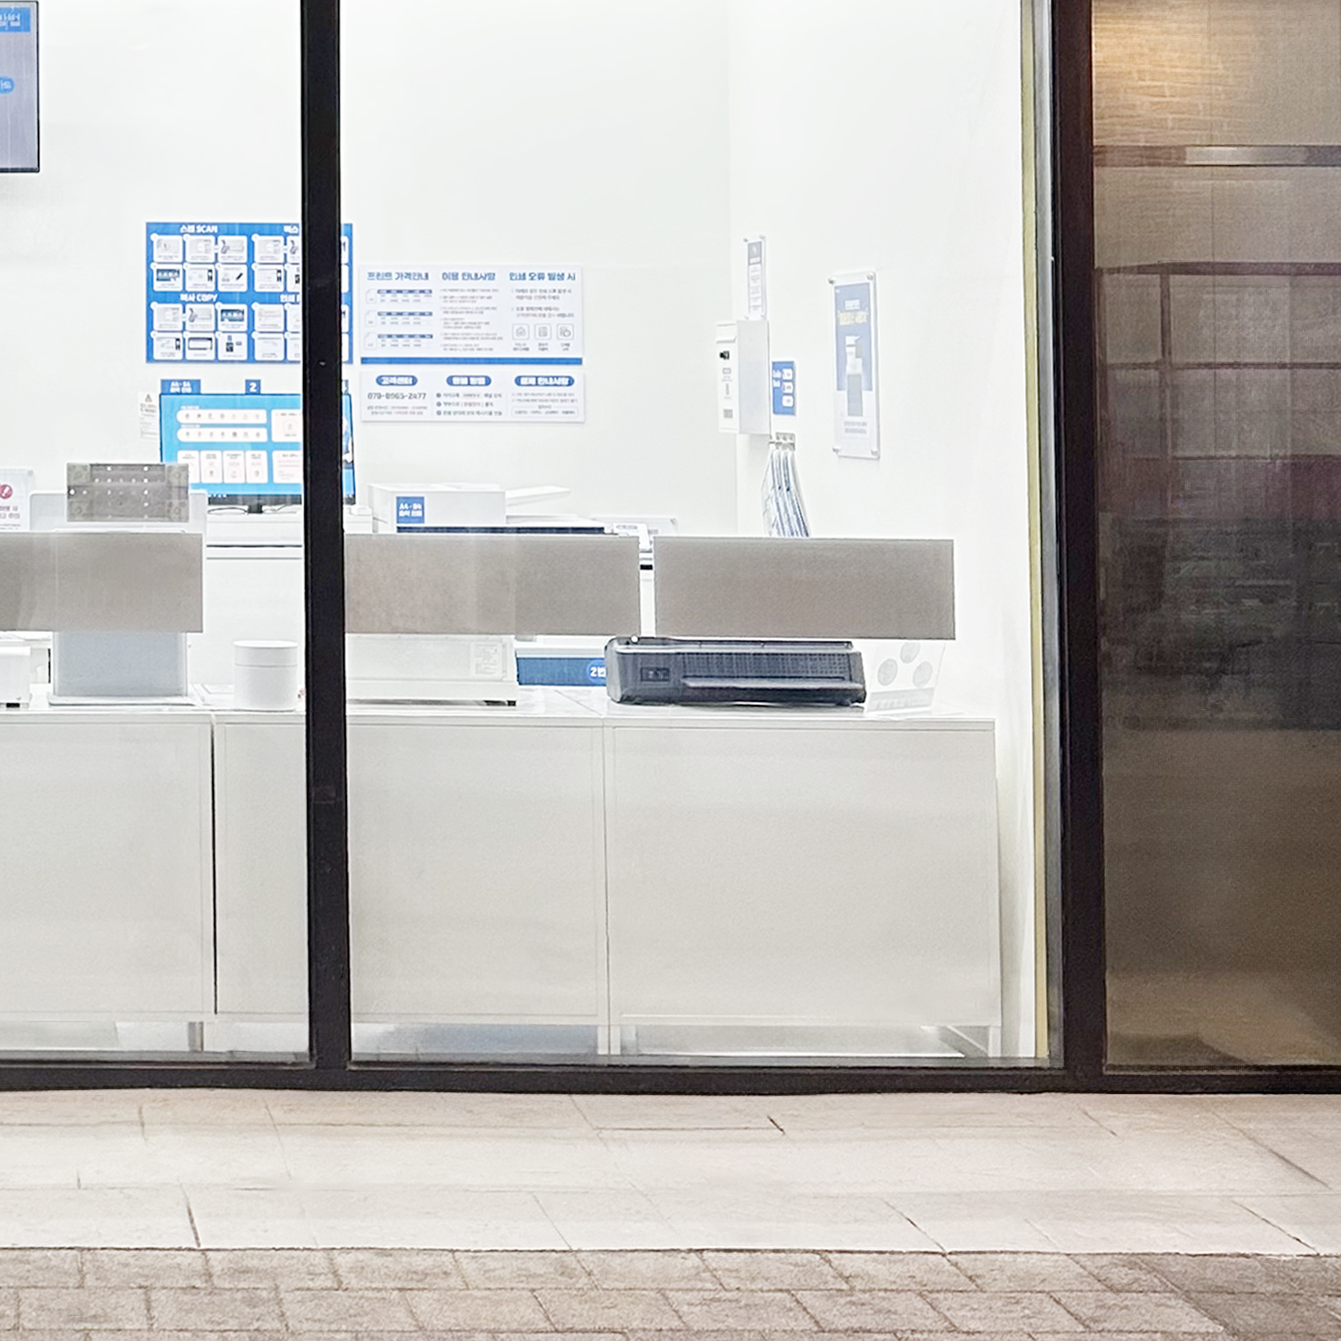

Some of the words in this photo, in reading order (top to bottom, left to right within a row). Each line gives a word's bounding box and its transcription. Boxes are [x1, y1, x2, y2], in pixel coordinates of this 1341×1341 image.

[196, 225, 218, 233] SCAN
[197, 294, 219, 302] COPY
[249, 382, 258, 392] 2
